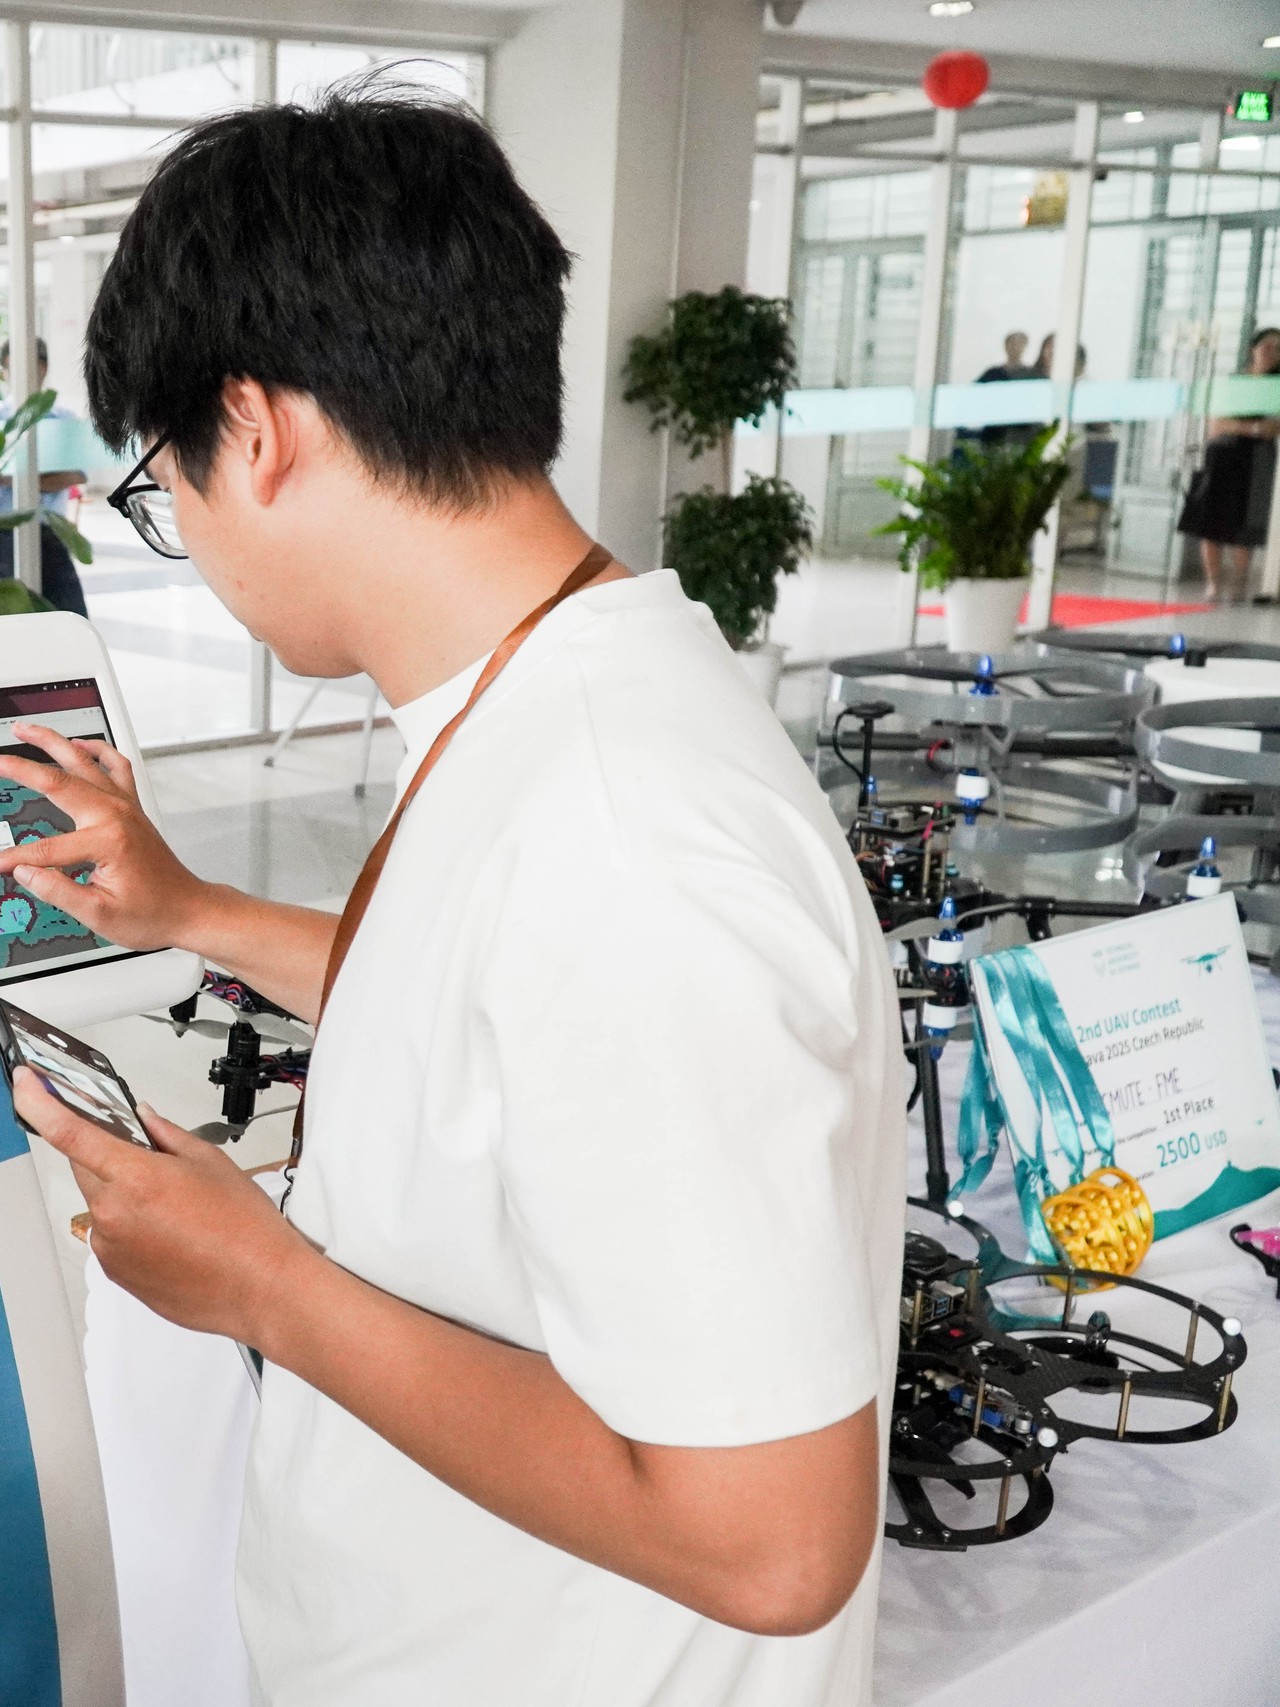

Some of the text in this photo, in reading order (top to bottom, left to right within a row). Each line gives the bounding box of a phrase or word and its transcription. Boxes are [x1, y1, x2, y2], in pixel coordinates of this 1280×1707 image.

[1077, 998, 1182, 1043] 2nd UAV Contest
[1106, 1040, 1132, 1060] 2025
[1133, 1032, 1161, 1051] Czech
[1163, 1017, 1205, 1040] Republic
[1163, 1096, 1214, 1124] 1st Place
[1157, 1130, 1227, 1167] 2500 USD
